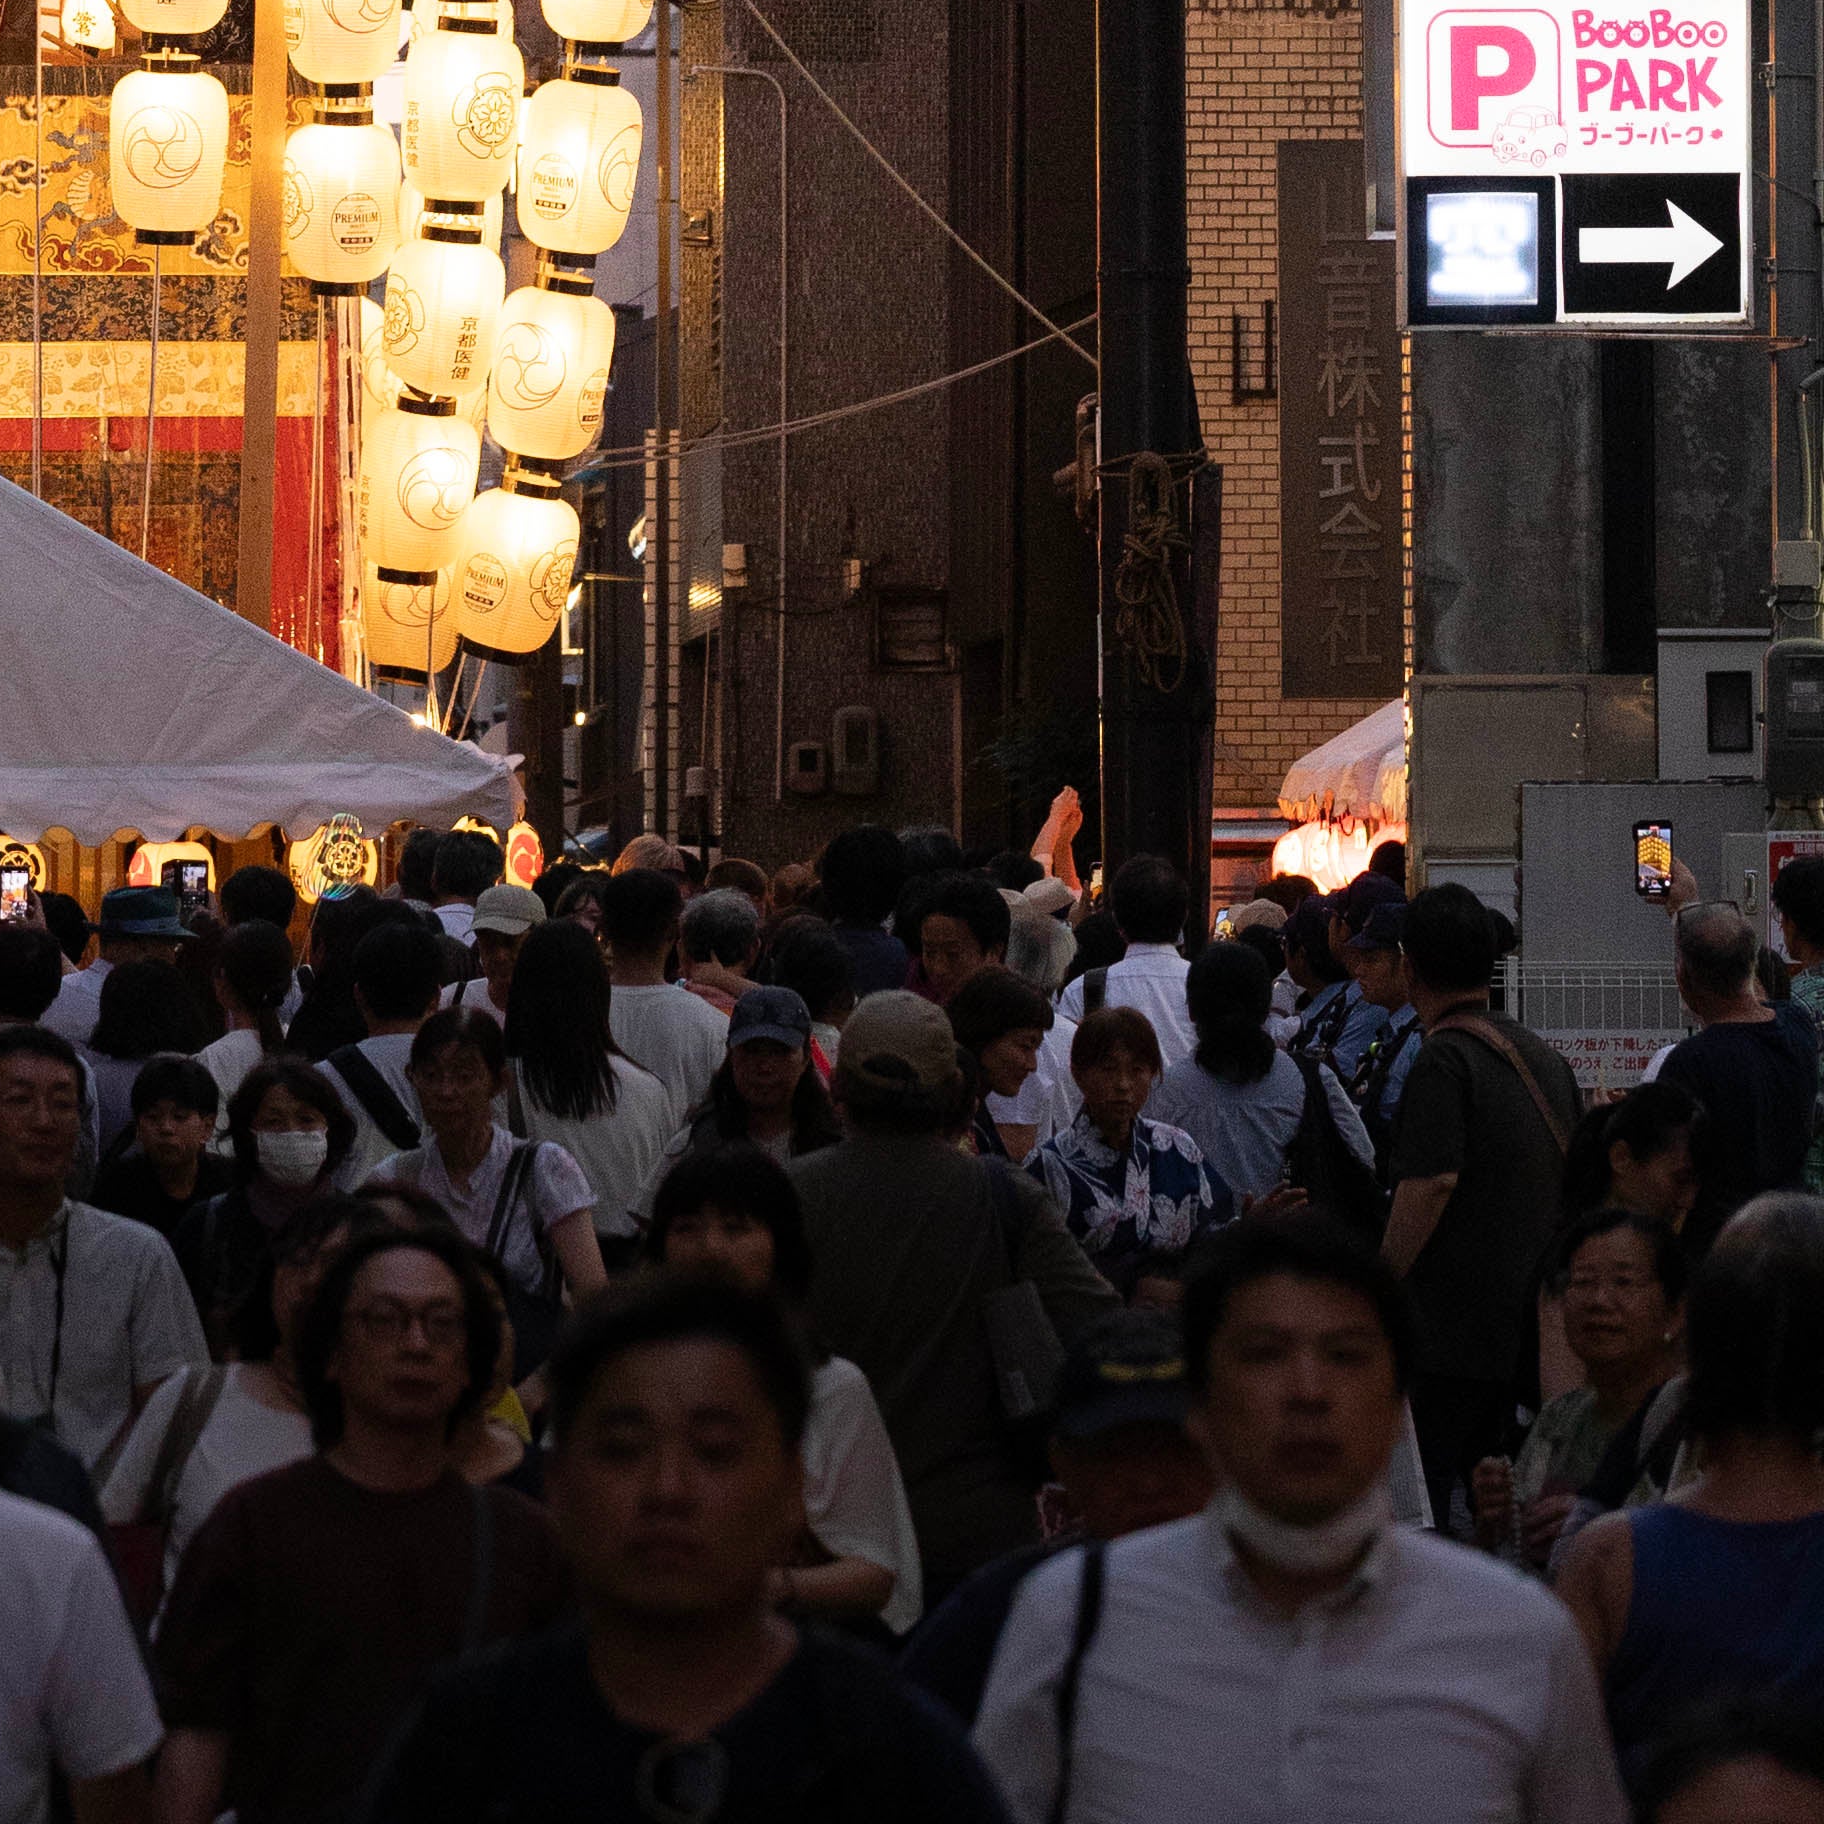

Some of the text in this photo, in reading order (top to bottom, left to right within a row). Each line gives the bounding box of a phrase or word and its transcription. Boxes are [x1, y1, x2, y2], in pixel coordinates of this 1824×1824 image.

[1450, 25, 1537, 131] P
[1575, 56, 1724, 114] PARK
[1580, 124, 1706, 147] ブーブーパーク
[335, 212, 378, 224] PREMIUM
[451, 317, 478, 381] 京都医健
